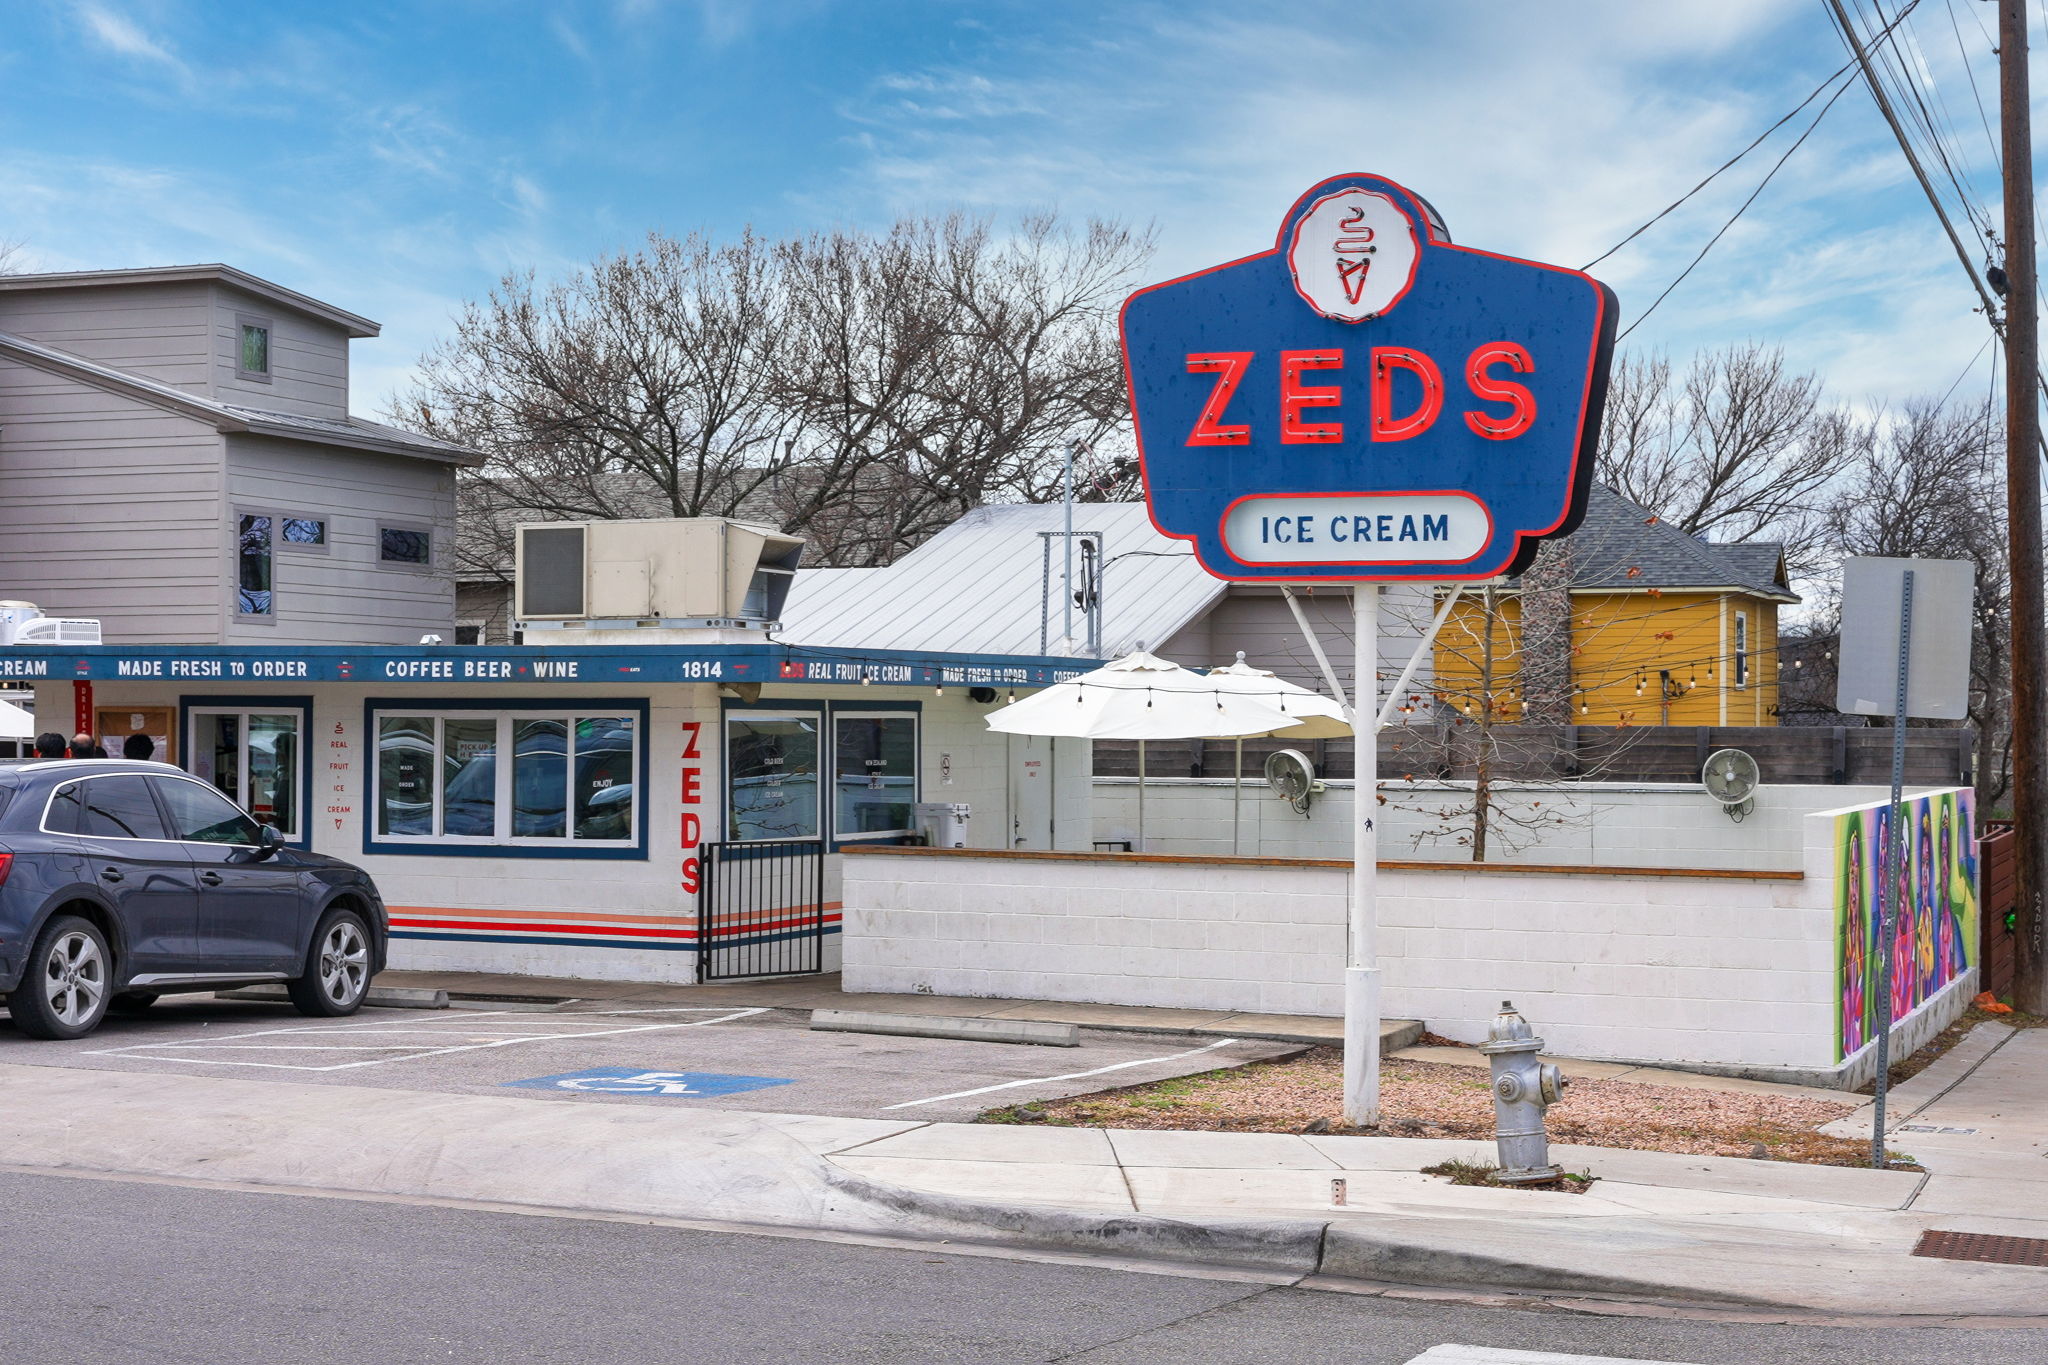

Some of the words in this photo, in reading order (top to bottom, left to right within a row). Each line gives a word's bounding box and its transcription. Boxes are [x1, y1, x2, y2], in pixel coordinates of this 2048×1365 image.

[1185, 341, 1537, 446] ZEDS
[1262, 516, 1314, 543] ICE
[1330, 514, 1448, 543] CREAM
[118, 660, 162, 676] MADE
[171, 660, 222, 676] FRESH
[230, 662, 245, 676] TO
[252, 660, 307, 677] ORDER
[385, 661, 453, 677] COFFEE
[464, 661, 512, 677] BEER
[533, 661, 578, 678] WINE
[682, 661, 722, 678] 1814
[808, 662, 832, 679] REAL
[835, 664, 862, 680] FRUIT
[882, 665, 912, 682] CREAM
[943, 667, 965, 682] MADE
[967, 667, 991, 683] FRESH
[1003, 669, 1027, 684] ORDER
[330, 741, 348, 749] REAL
[329, 762, 349, 770] FRUIT
[333, 784, 345, 792] ICE
[592, 778, 613, 788] ENJOY
[681, 721, 701, 895] ZEDS
